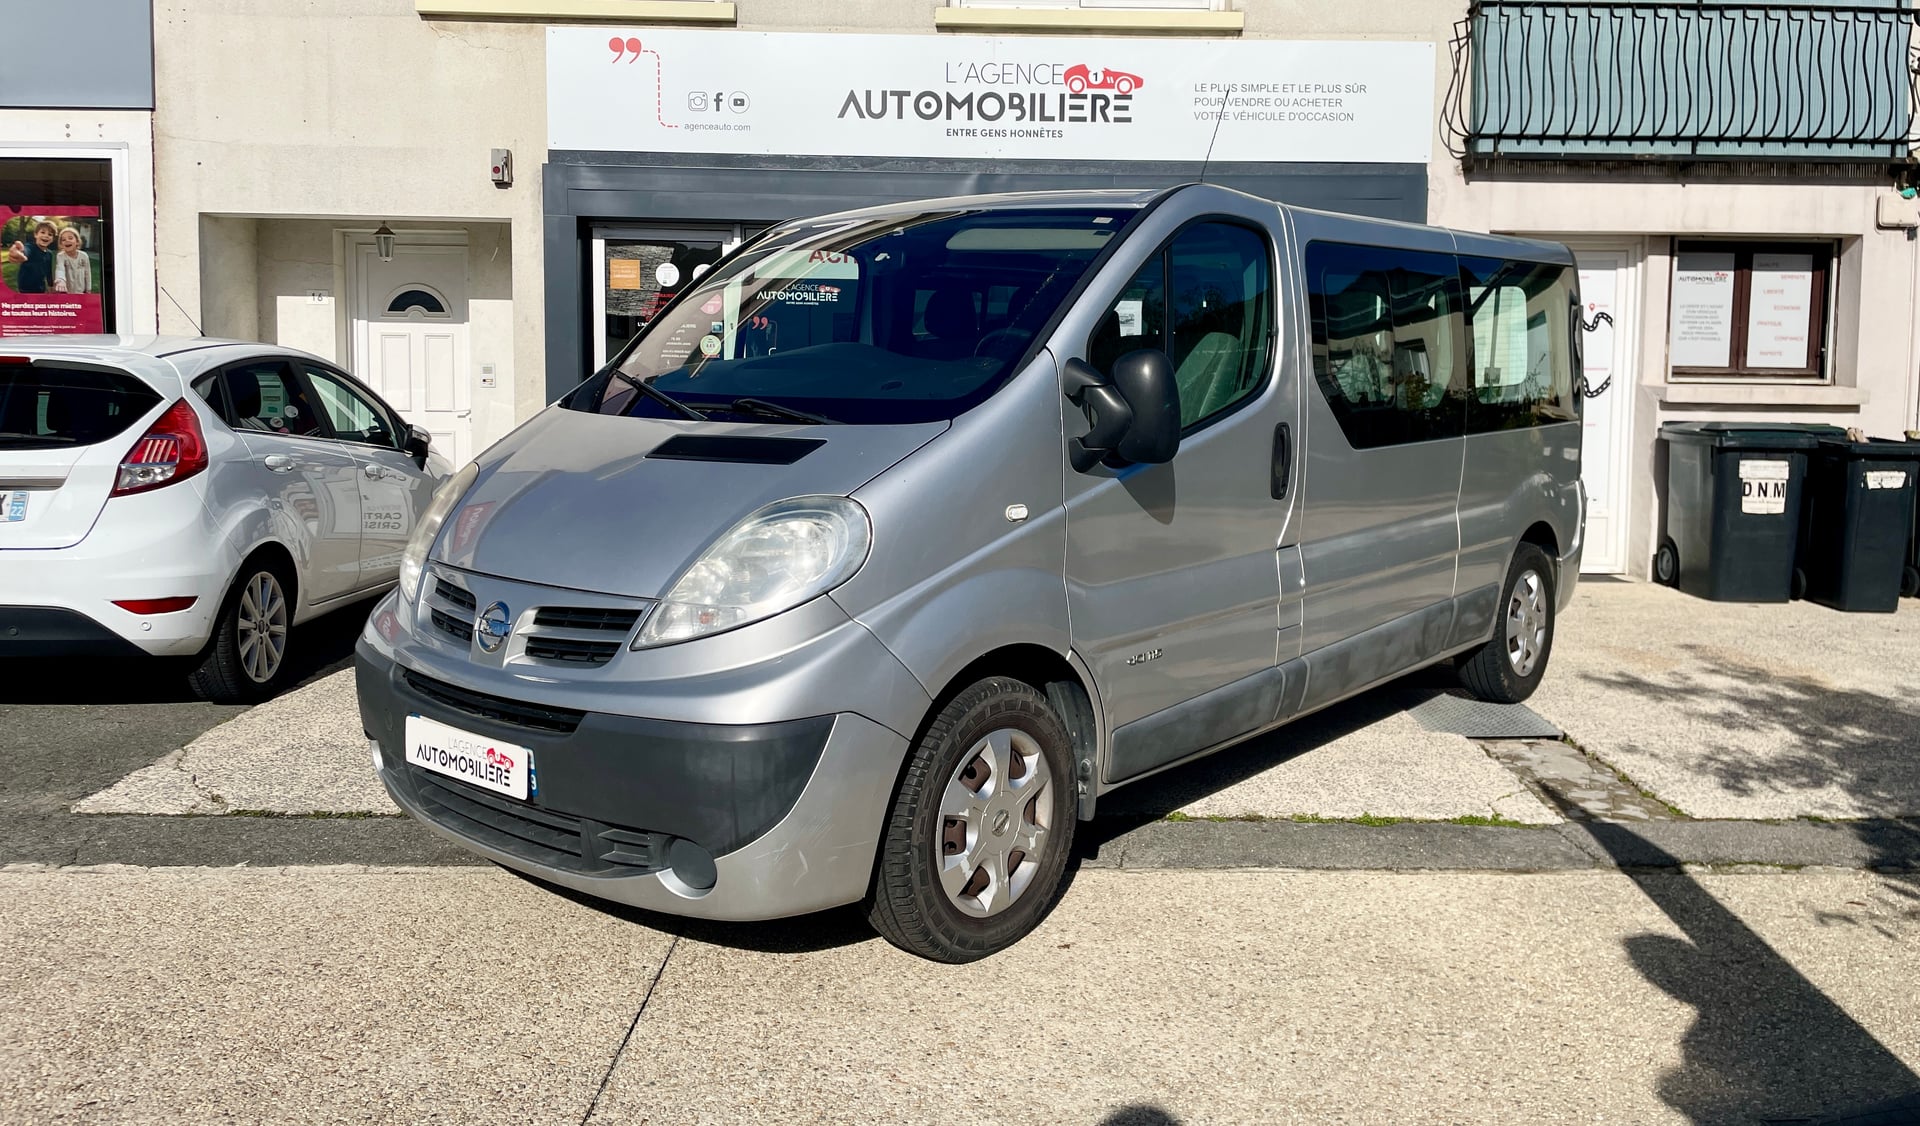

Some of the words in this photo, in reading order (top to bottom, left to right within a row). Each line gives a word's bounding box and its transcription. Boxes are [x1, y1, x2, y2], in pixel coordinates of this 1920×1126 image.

[946, 62, 1064, 85] L'AGENCE
[1194, 83, 1208, 92] LE
[1210, 83, 1238, 92] PLUS
[1240, 84, 1280, 92] SIMPLE
[1282, 84, 1296, 93] ET
[1298, 84, 1311, 93] LE
[1314, 84, 1342, 93] PLUS
[1344, 82, 1367, 93] SÛR
[1194, 97, 1224, 106] POUR
[1228, 97, 1272, 106] VENDRE
[1274, 98, 1290, 107] OU
[1292, 98, 1343, 107] ACHETER
[1194, 112, 1230, 120] VOTRE
[1232, 110, 1286, 120] VÉHICULE
[1288, 112, 1354, 121] D'OCCASION
[684, 123, 751, 132] agenceauto.com
[946, 128, 978, 137] ENTRE
[980, 129, 1007, 138] GENS
[1010, 127, 1063, 138] HONNÊTES
[11, 506, 24, 517] 22
[448, 737, 487, 760] L'AGENCE
